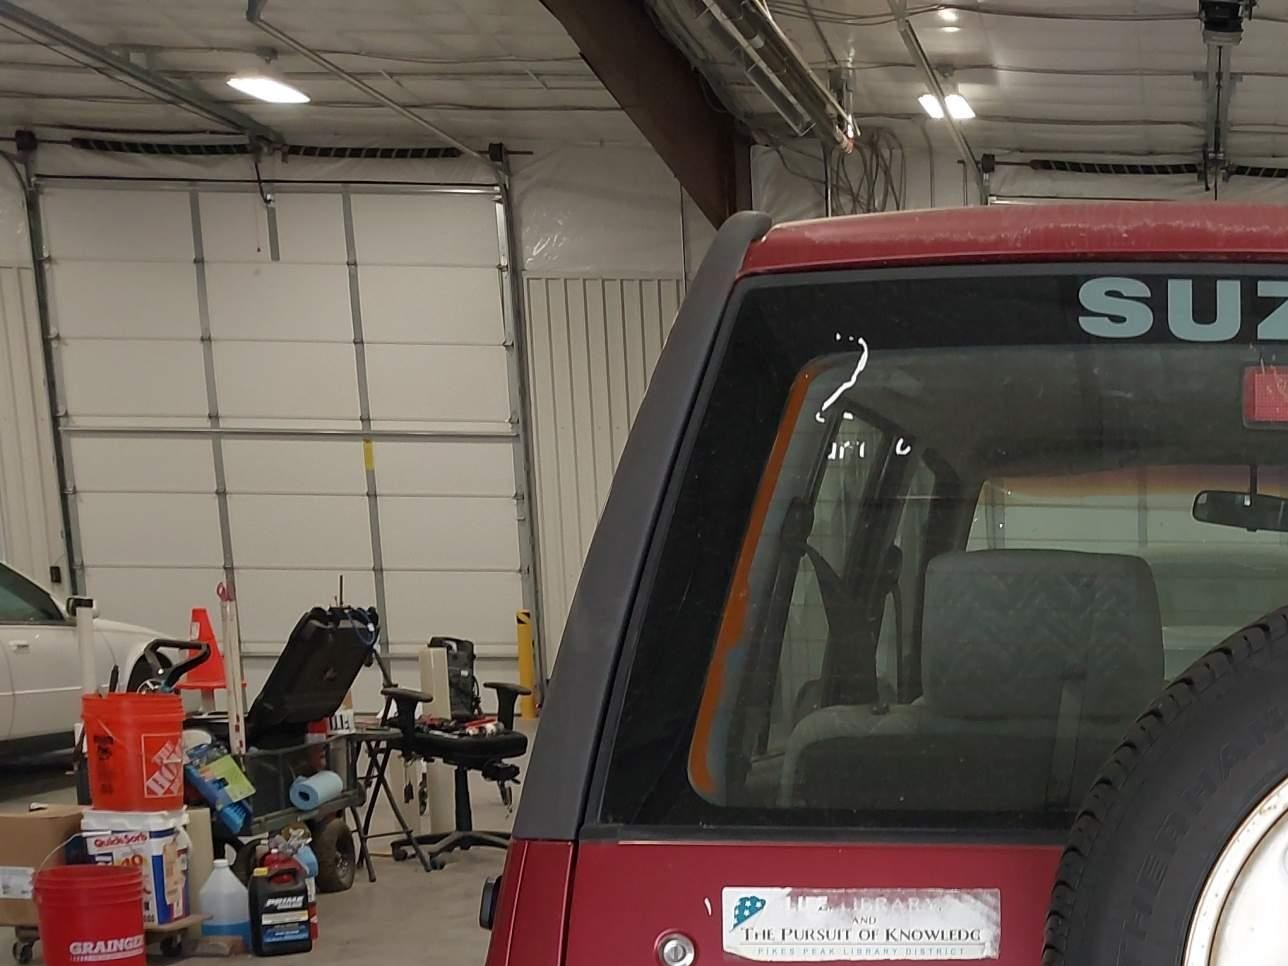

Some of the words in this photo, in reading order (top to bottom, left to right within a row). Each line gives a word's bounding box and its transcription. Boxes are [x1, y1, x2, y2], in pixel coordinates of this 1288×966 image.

[852, 916, 877, 924] AND
[757, 947, 796, 957] PIKES
[803, 947, 836, 957] PEAK
[843, 947, 898, 957] LIBRARY
[905, 947, 965, 957] DISTRICT
